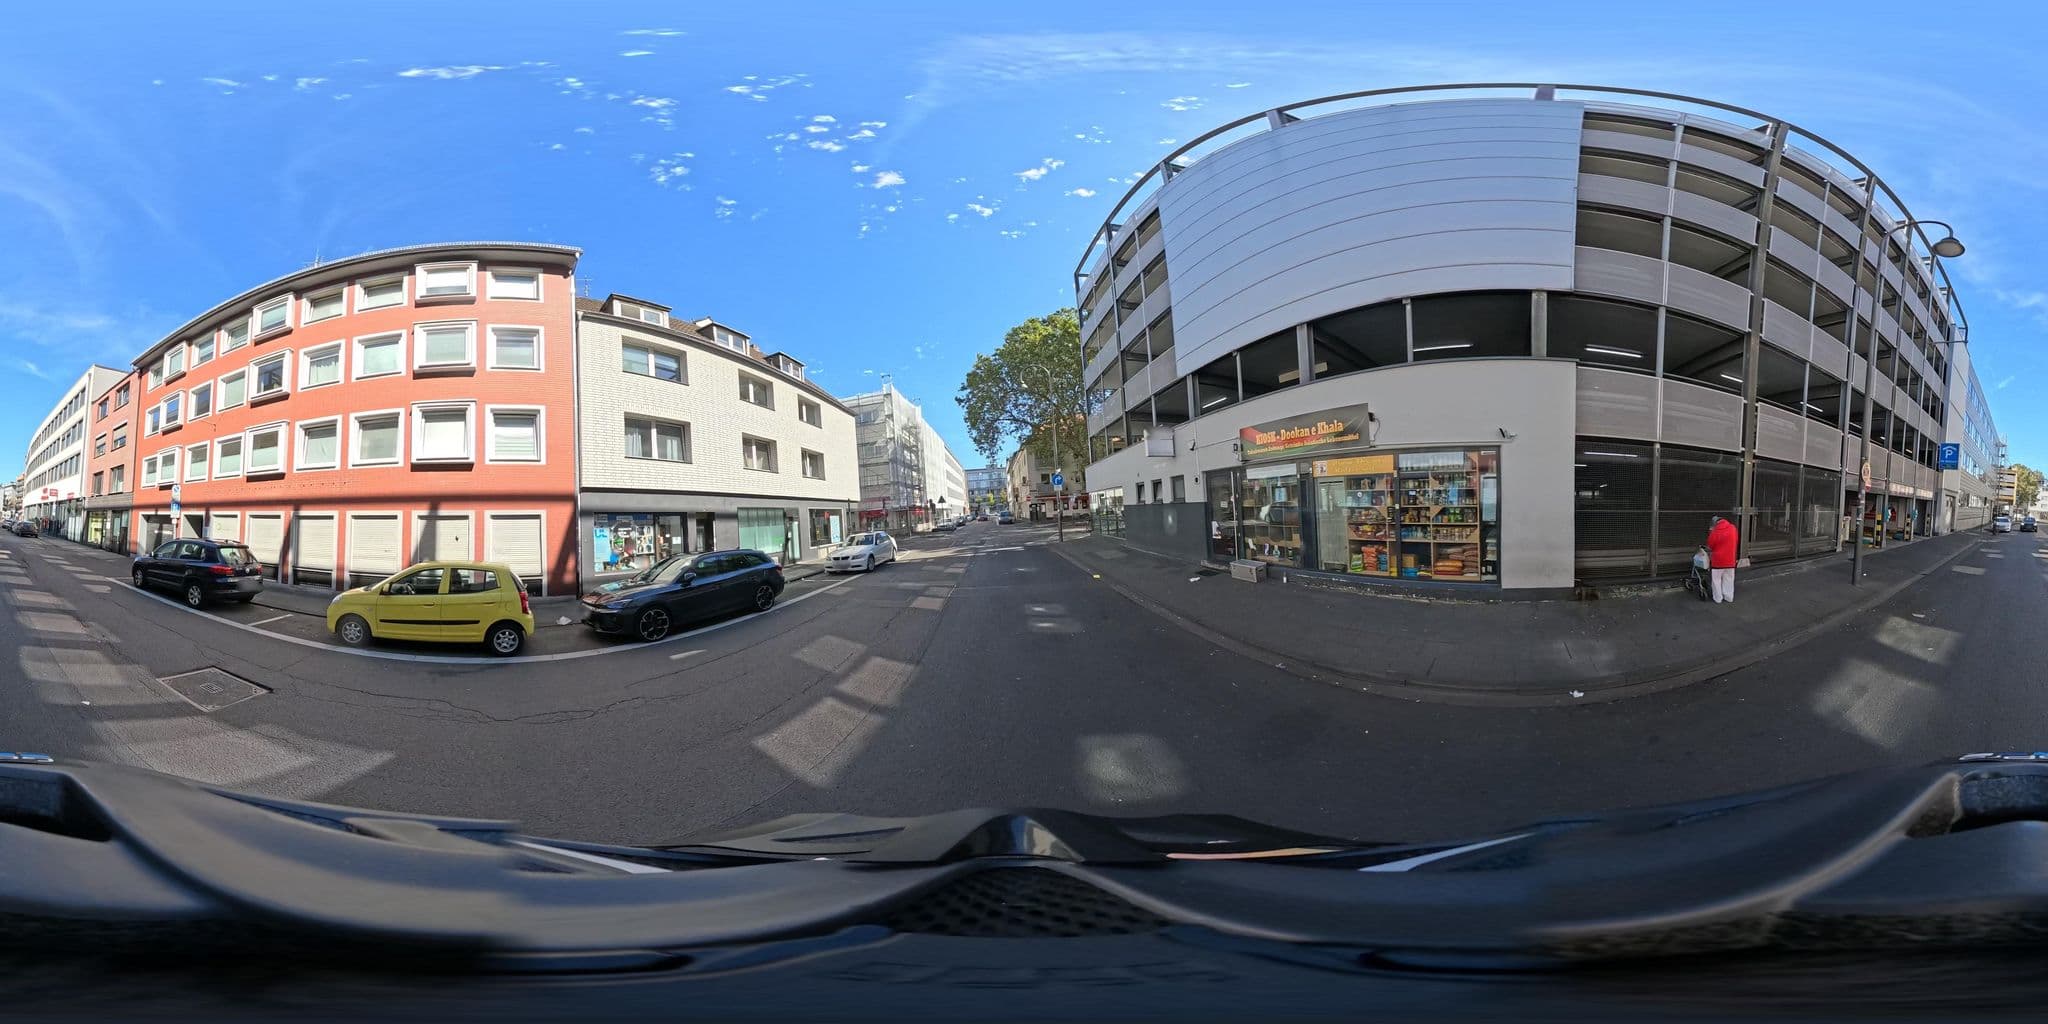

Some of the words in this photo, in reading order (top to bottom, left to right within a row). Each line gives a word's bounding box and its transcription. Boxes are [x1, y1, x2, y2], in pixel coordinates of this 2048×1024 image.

[1256, 431, 1277, 445] KIOSK
[1281, 426, 1310, 441] Dookan
[1311, 426, 1317, 436] e
[1317, 420, 1344, 434] Khala
